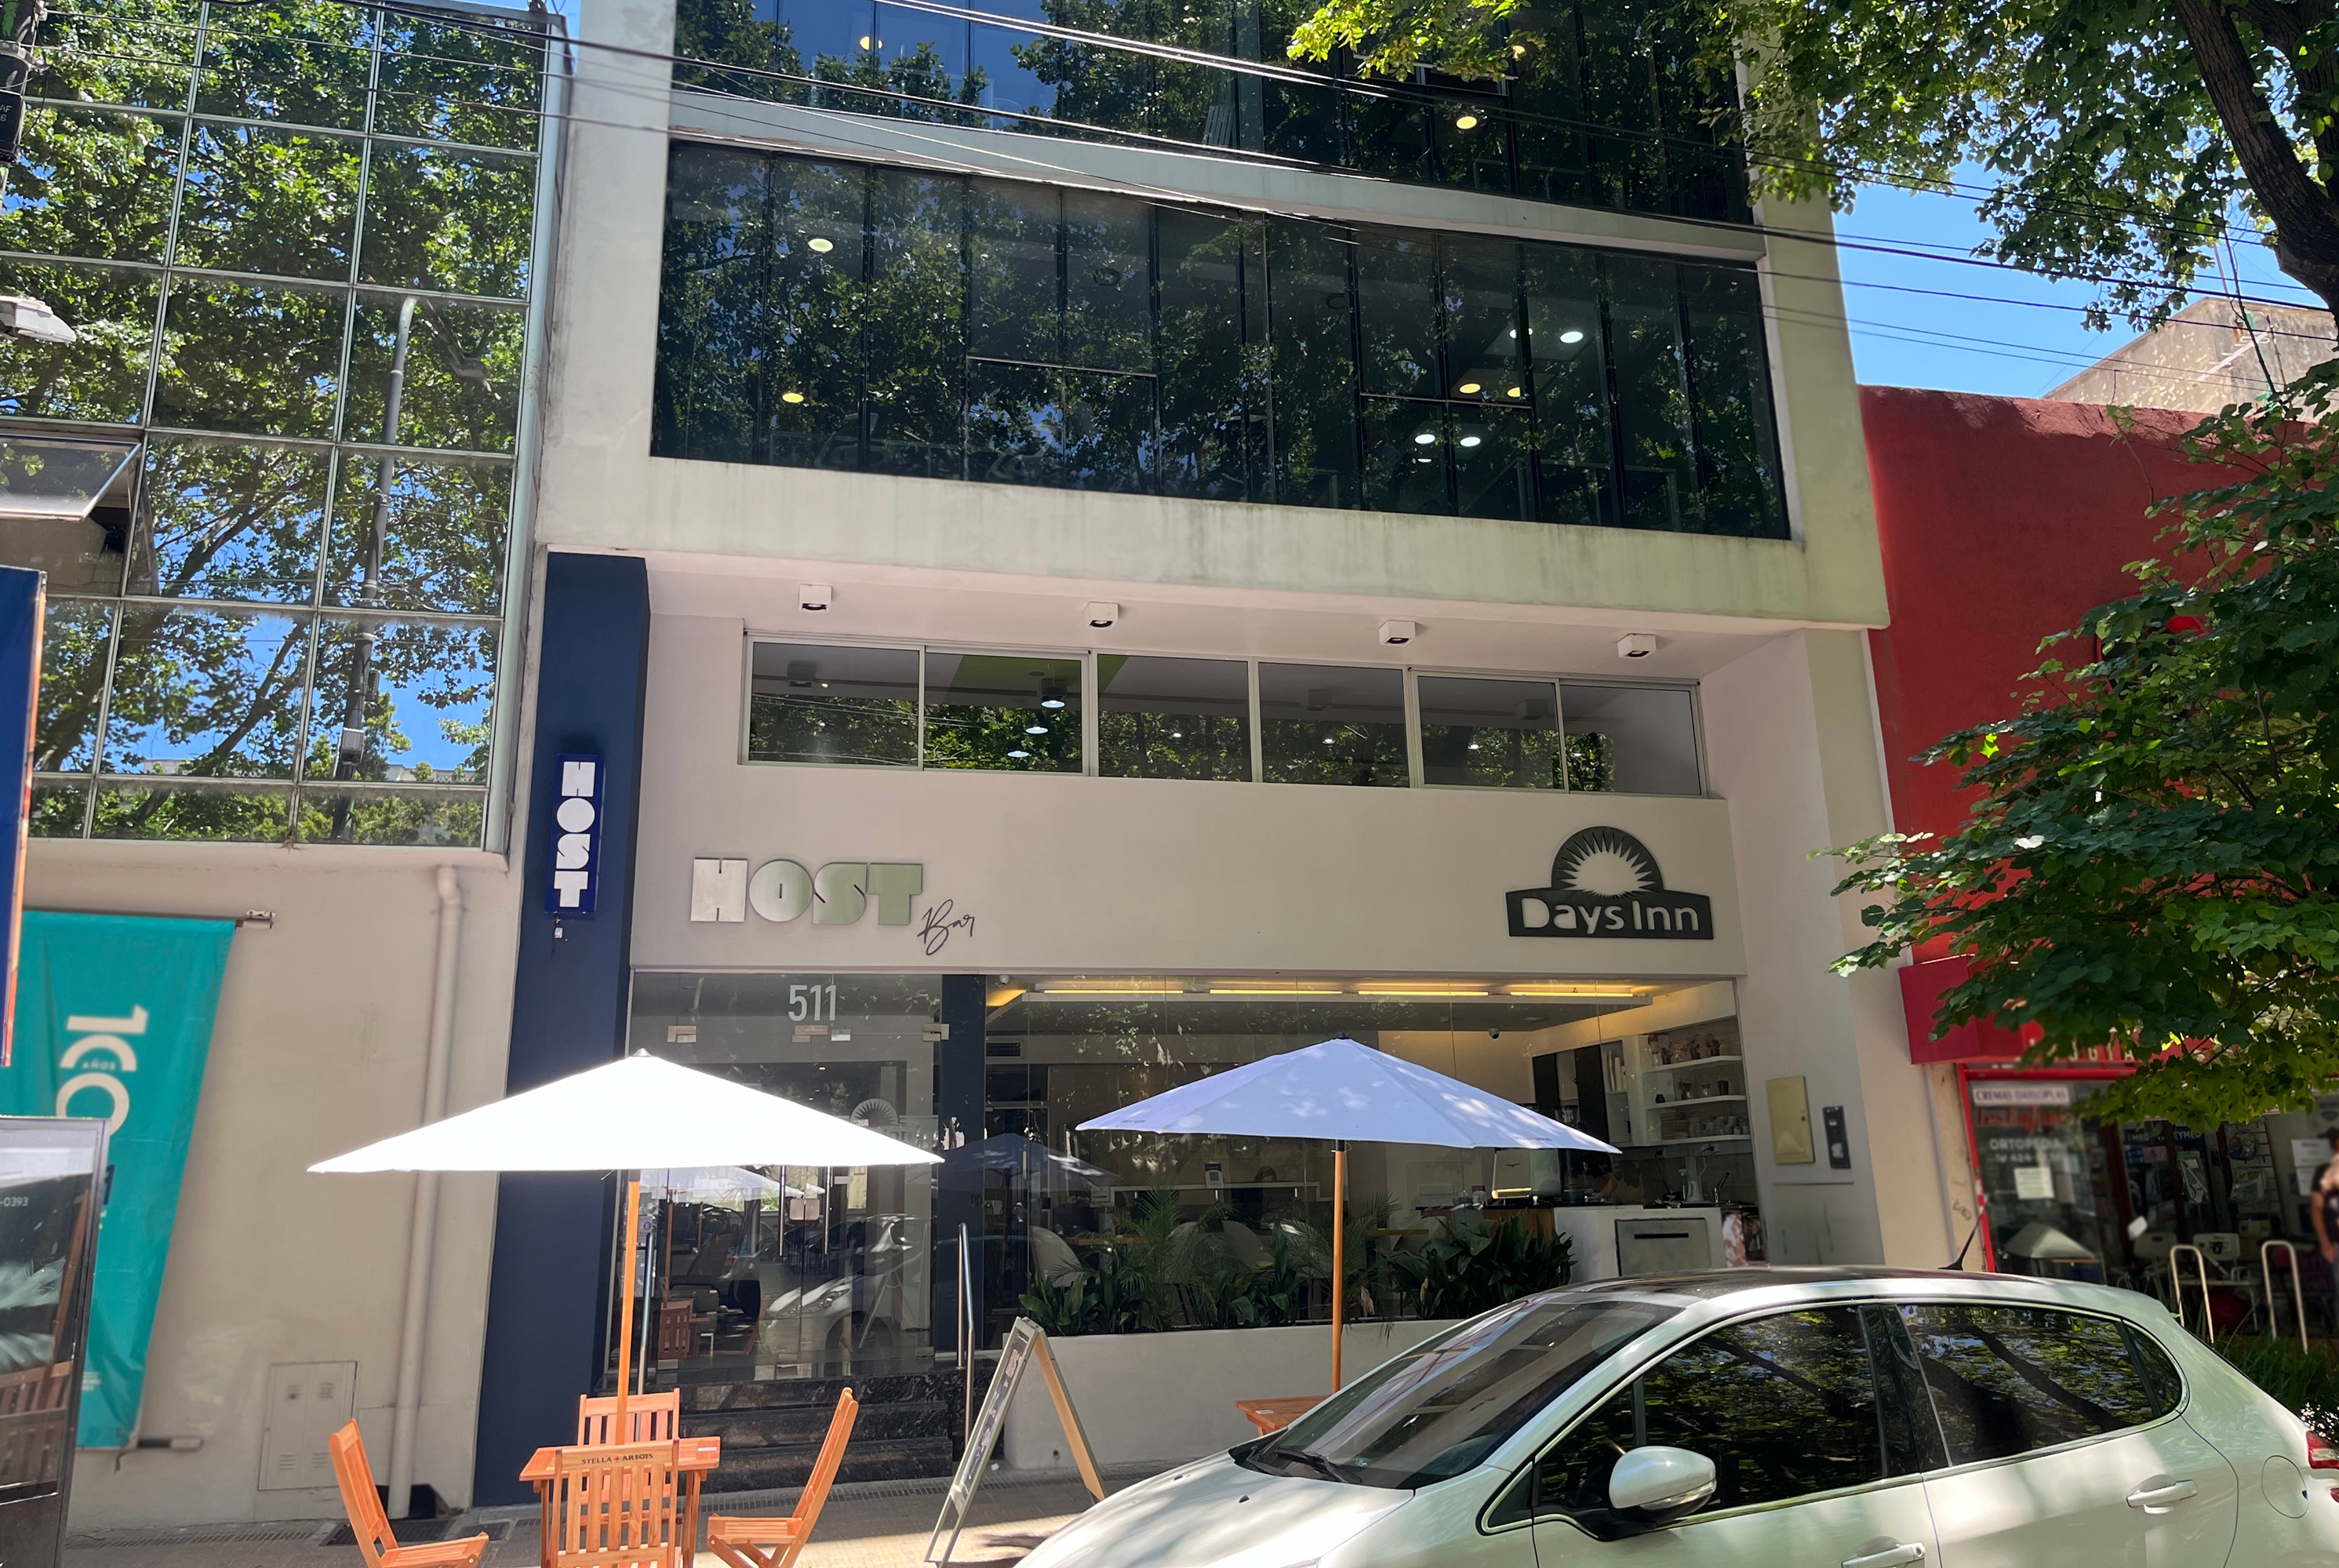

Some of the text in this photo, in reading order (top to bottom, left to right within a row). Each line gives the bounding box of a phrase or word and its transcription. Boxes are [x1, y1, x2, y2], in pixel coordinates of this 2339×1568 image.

[554, 761, 596, 908] HOST
[690, 857, 923, 926] HOST
[917, 899, 975, 955] Bar
[1521, 897, 1700, 935] Days Inn
[788, 984, 836, 1021] 511
[82, 1060, 115, 1071] AÑOS
[1989, 1137, 2062, 1151] ORTOPEDIA
[581, 1453, 653, 1465] STELLA ARTOIS
